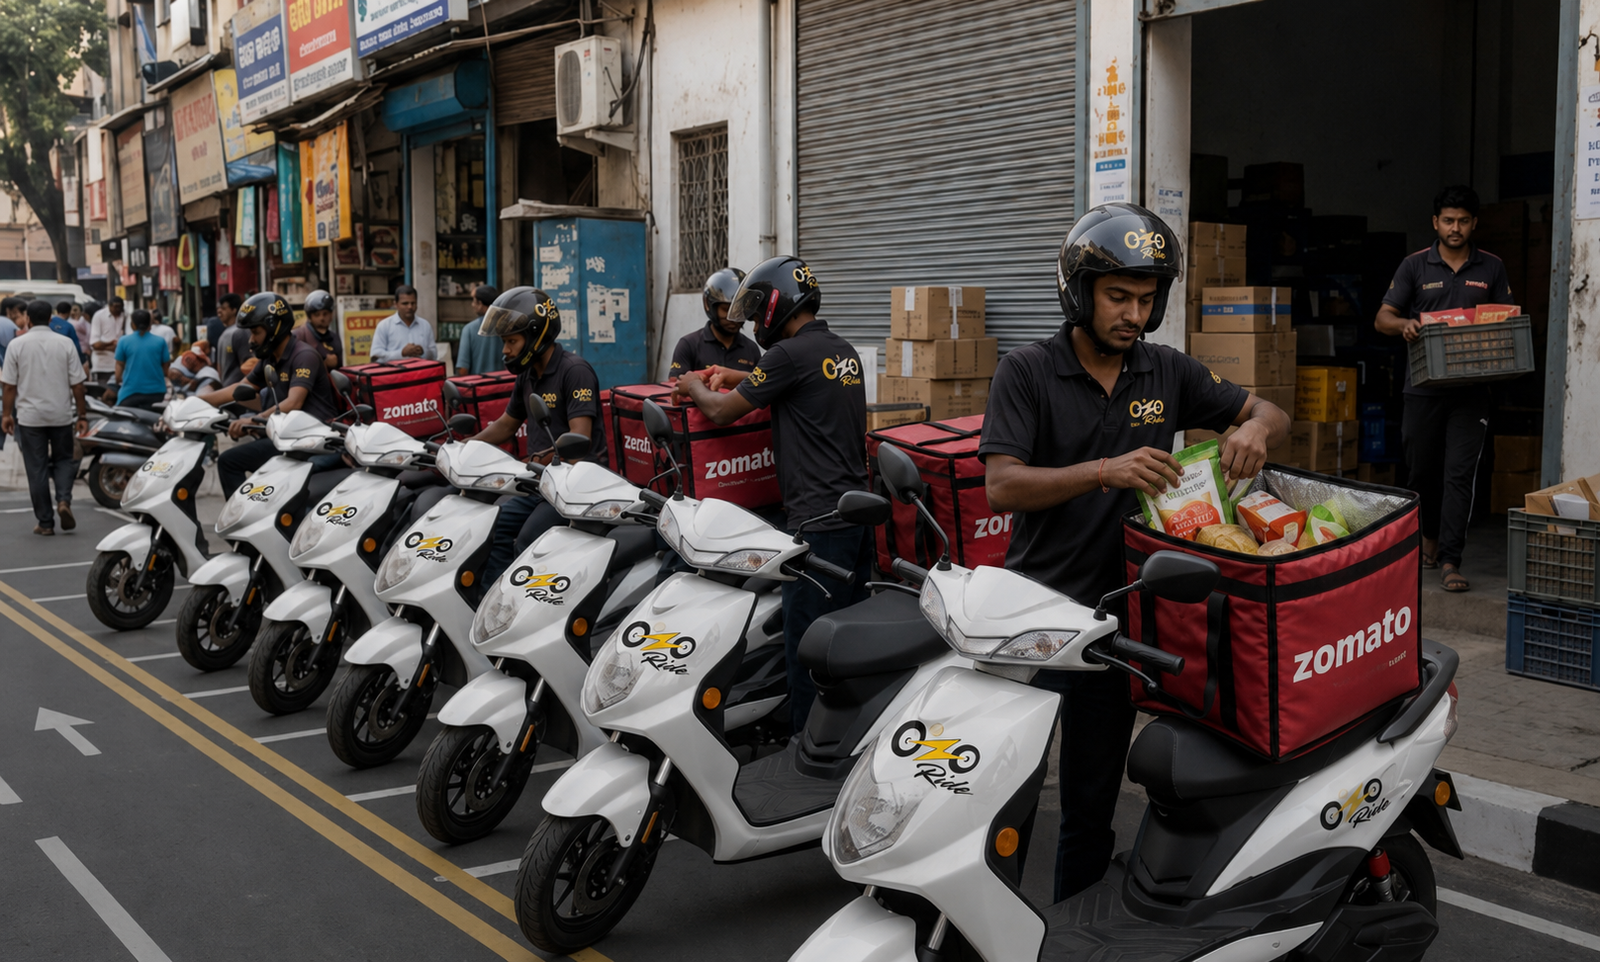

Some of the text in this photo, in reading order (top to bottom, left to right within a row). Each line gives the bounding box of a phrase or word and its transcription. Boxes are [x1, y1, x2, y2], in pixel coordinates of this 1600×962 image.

[383, 398, 438, 420] zomato
[1293, 606, 1411, 683] zomato
[641, 651, 690, 675] Ride
[914, 763, 974, 796] Ride
[1348, 797, 1391, 828] Ride
